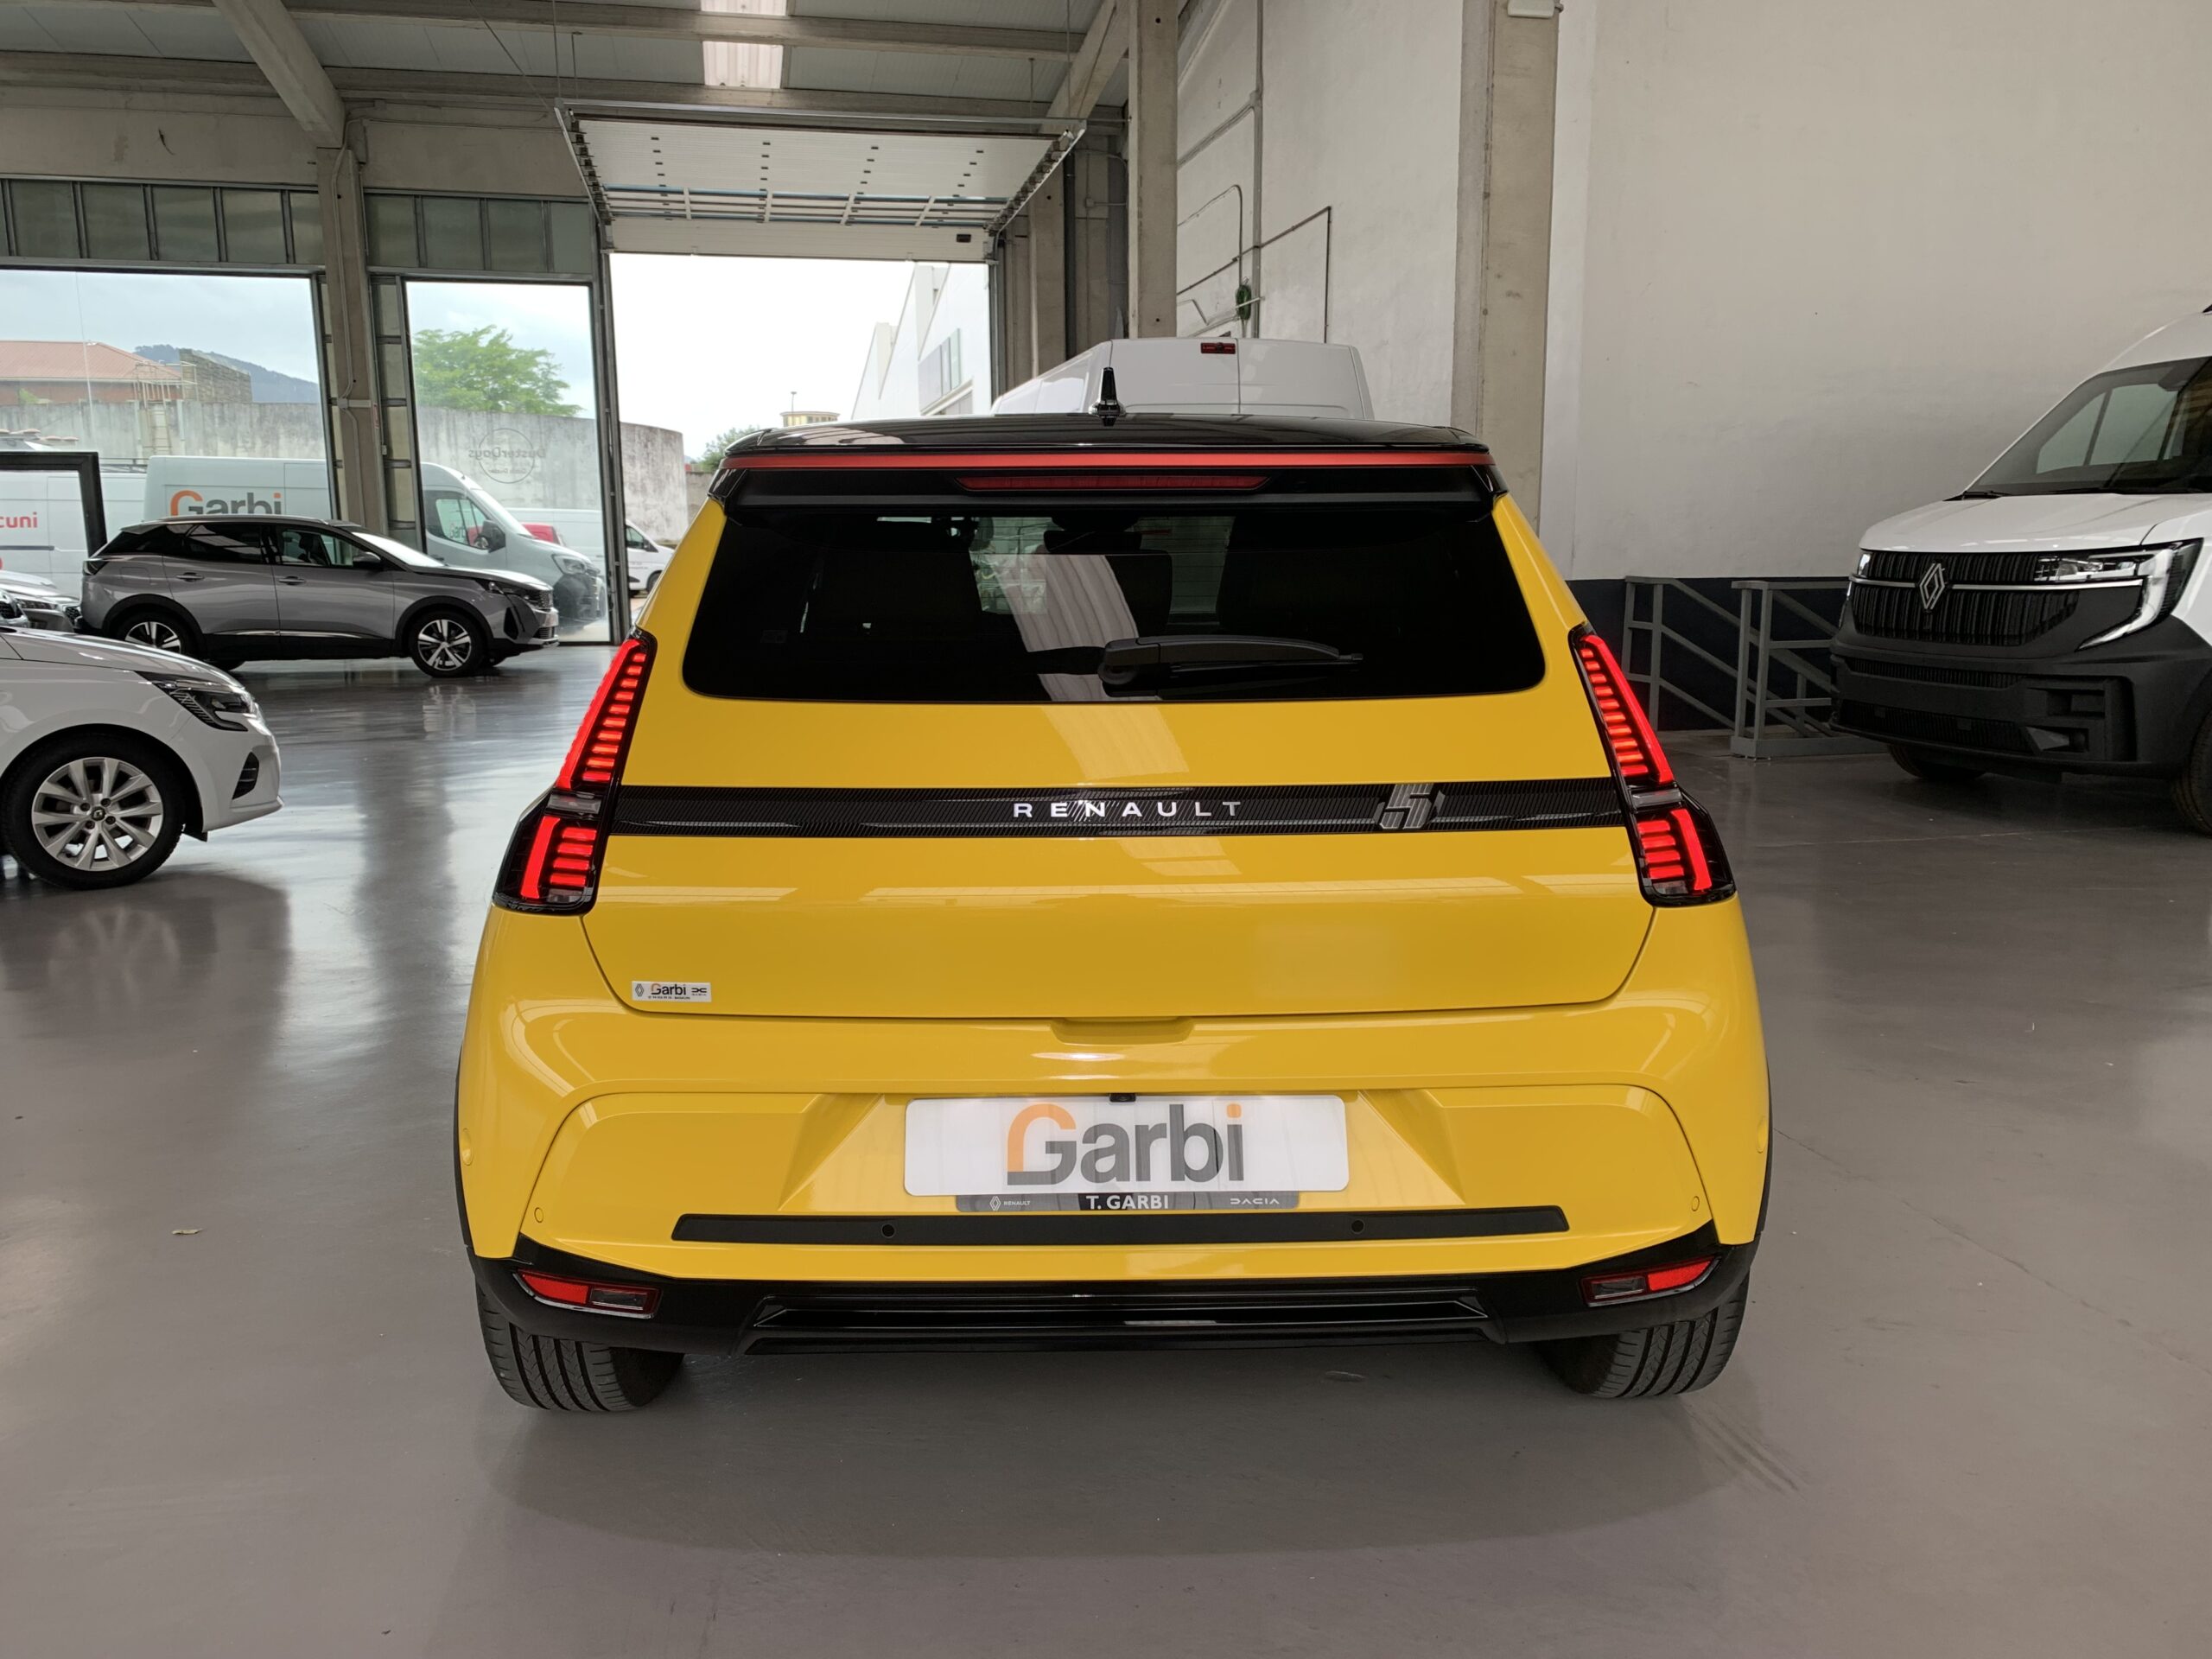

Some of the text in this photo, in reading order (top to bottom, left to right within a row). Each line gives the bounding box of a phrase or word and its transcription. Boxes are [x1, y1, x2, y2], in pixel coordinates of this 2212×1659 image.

[169, 489, 282, 517] Garbi
[1013, 800, 1241, 817] RENAULT
[651, 982, 687, 995] Garbi
[1007, 1103, 1244, 1186] Garbi
[1085, 1194, 1169, 1210] T. GARBI
